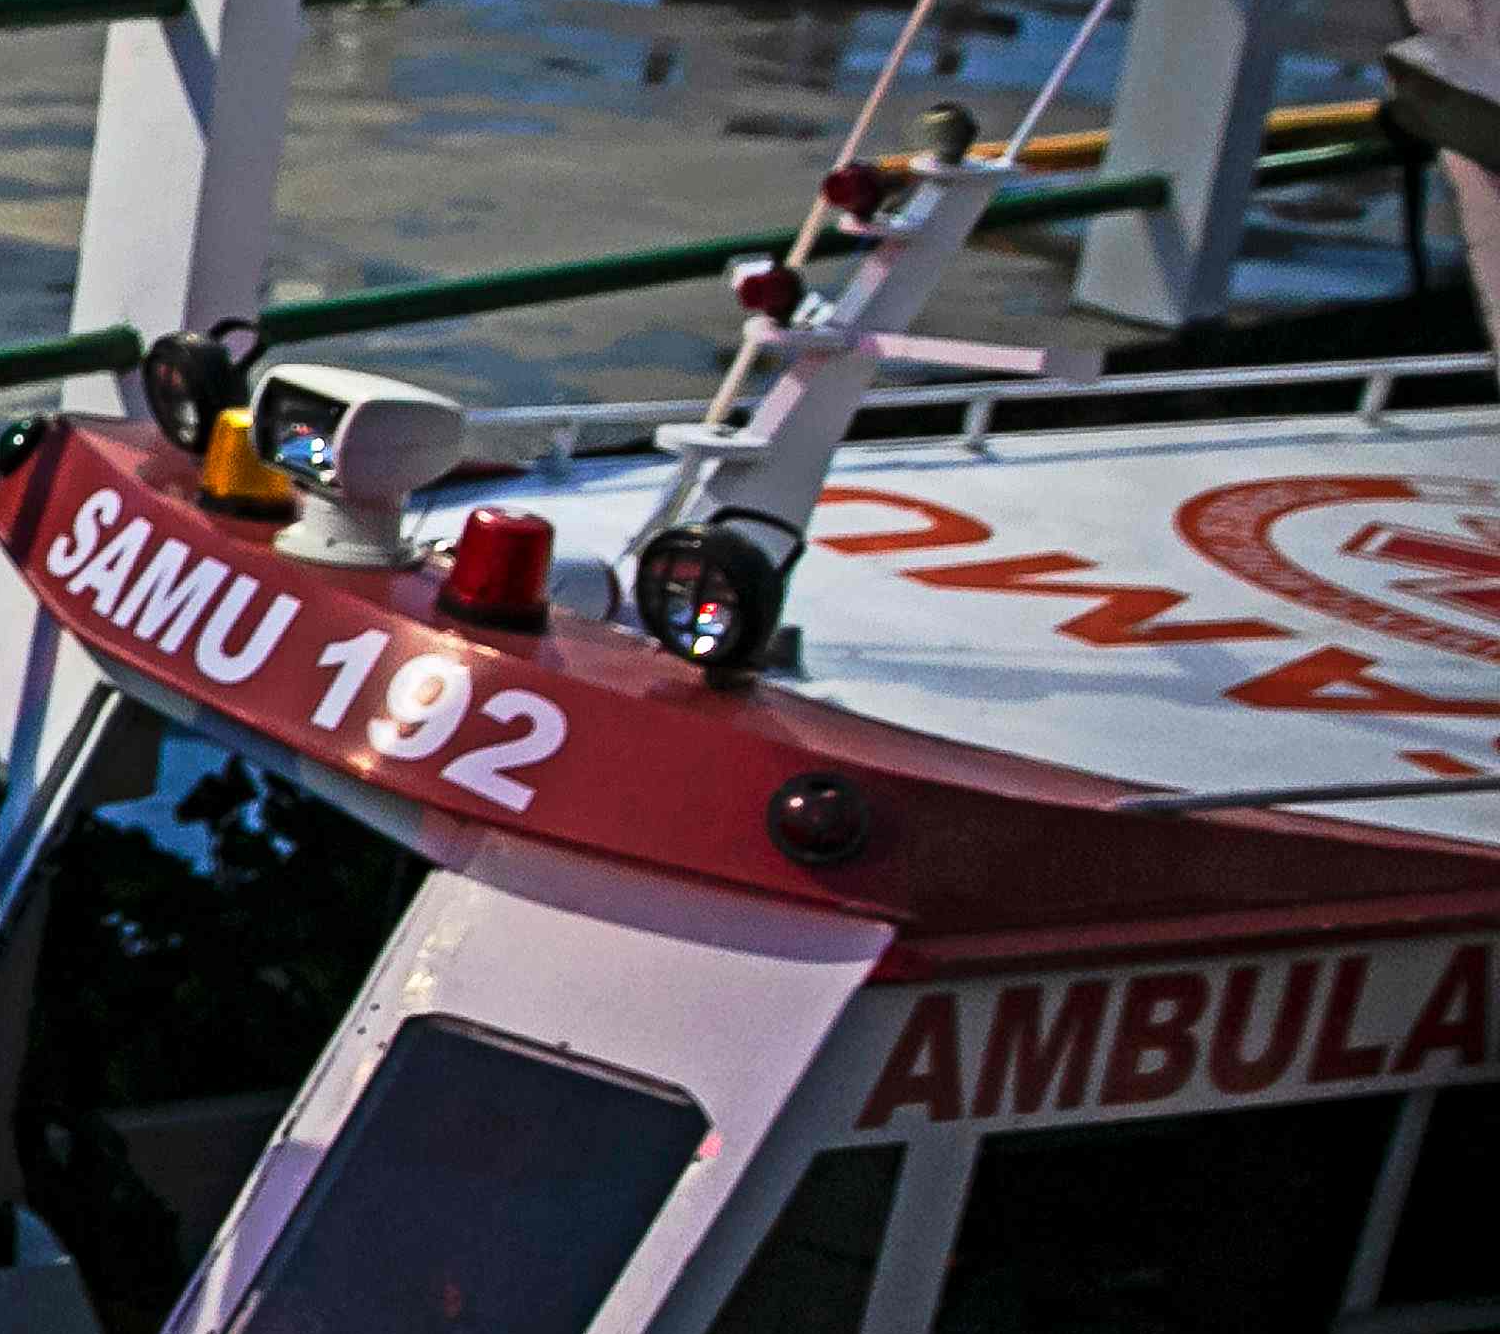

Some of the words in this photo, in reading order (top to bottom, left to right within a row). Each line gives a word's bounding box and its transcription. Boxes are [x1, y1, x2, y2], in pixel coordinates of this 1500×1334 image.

[46, 487, 303, 685] SAMU
[309, 628, 569, 814] 192
[853, 944, 1490, 1131] AMBULA
